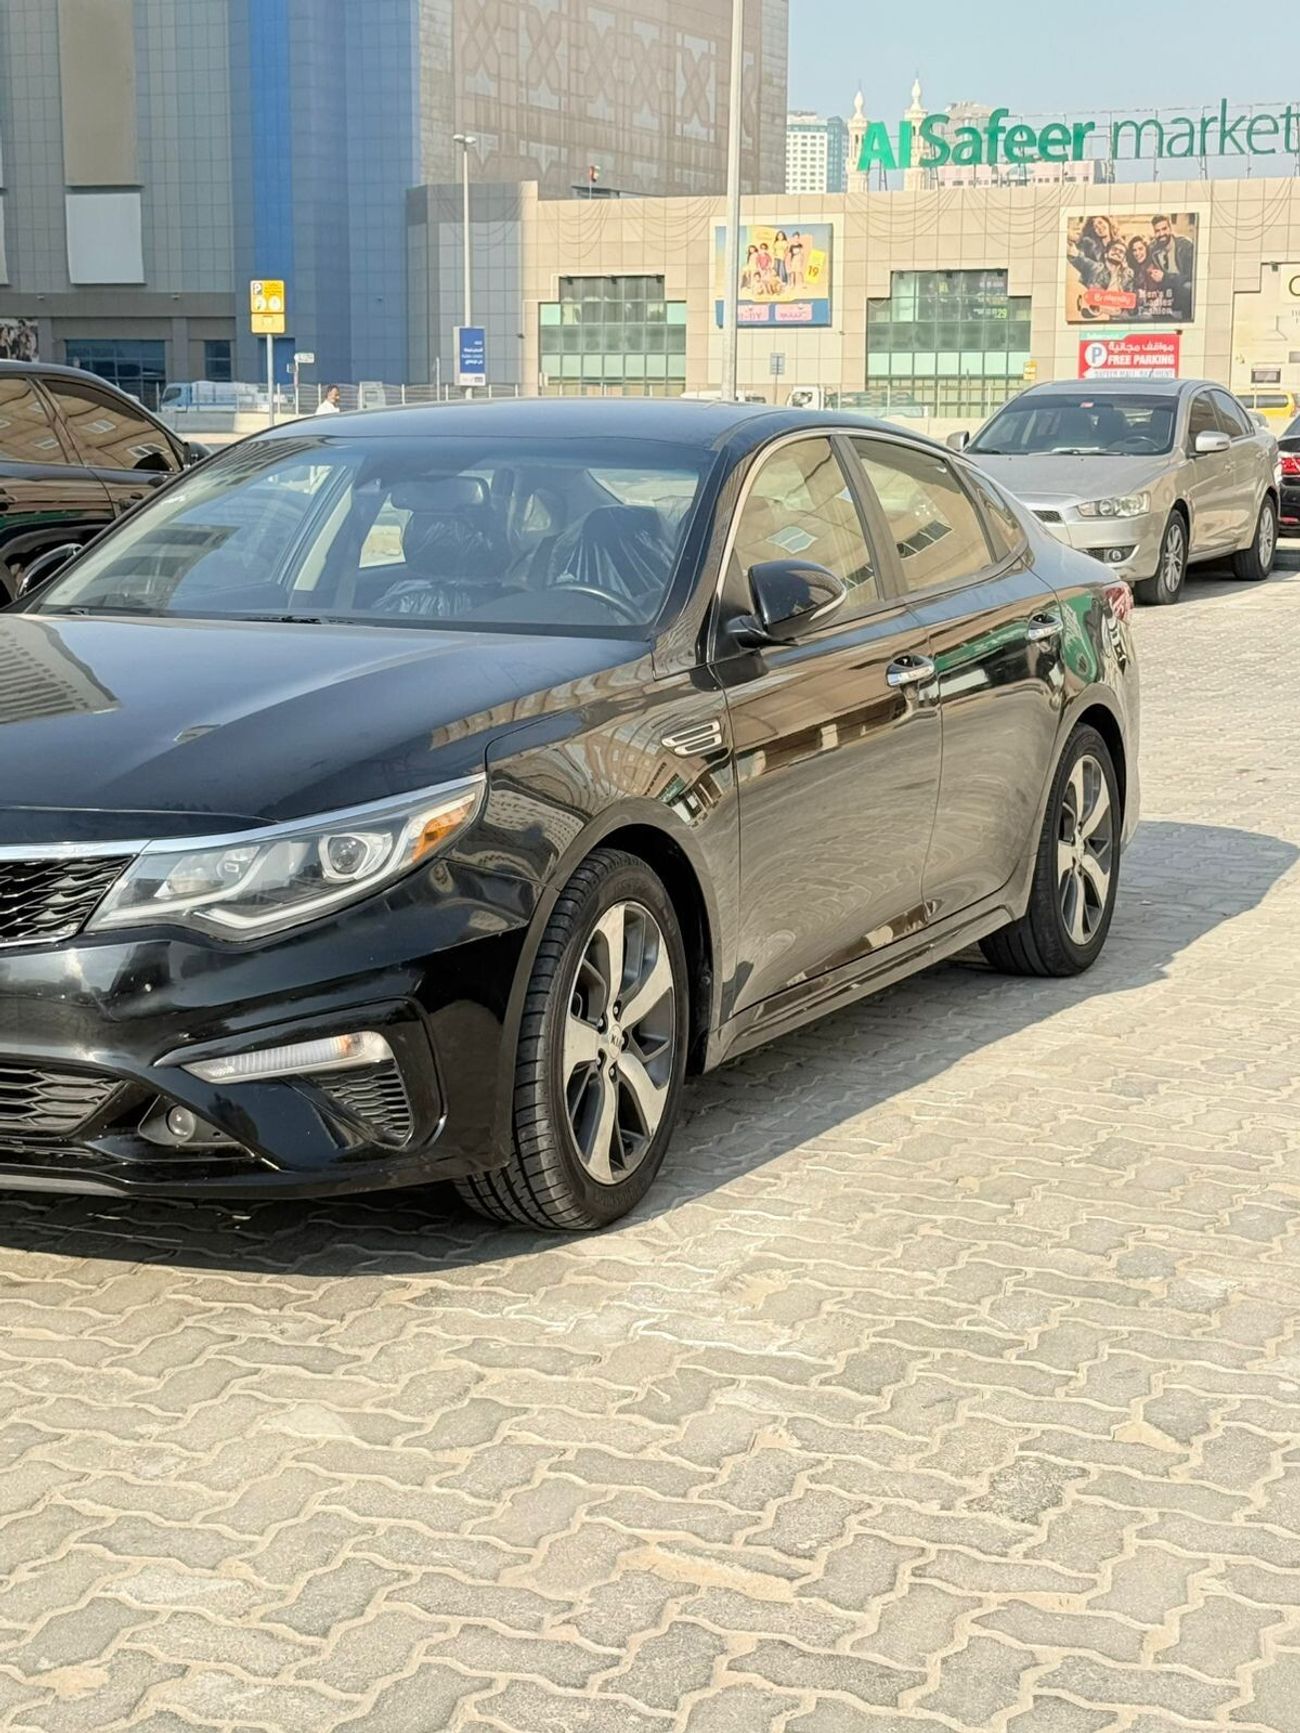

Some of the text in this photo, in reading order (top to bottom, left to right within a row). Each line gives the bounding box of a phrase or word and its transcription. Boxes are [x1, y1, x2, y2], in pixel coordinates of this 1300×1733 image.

[918, 107, 1096, 168] Safeer
[1112, 98, 1300, 160] market
[254, 283, 262, 295] P
[1091, 346, 1102, 363] P
[1107, 353, 1175, 366] FREE PARKING
